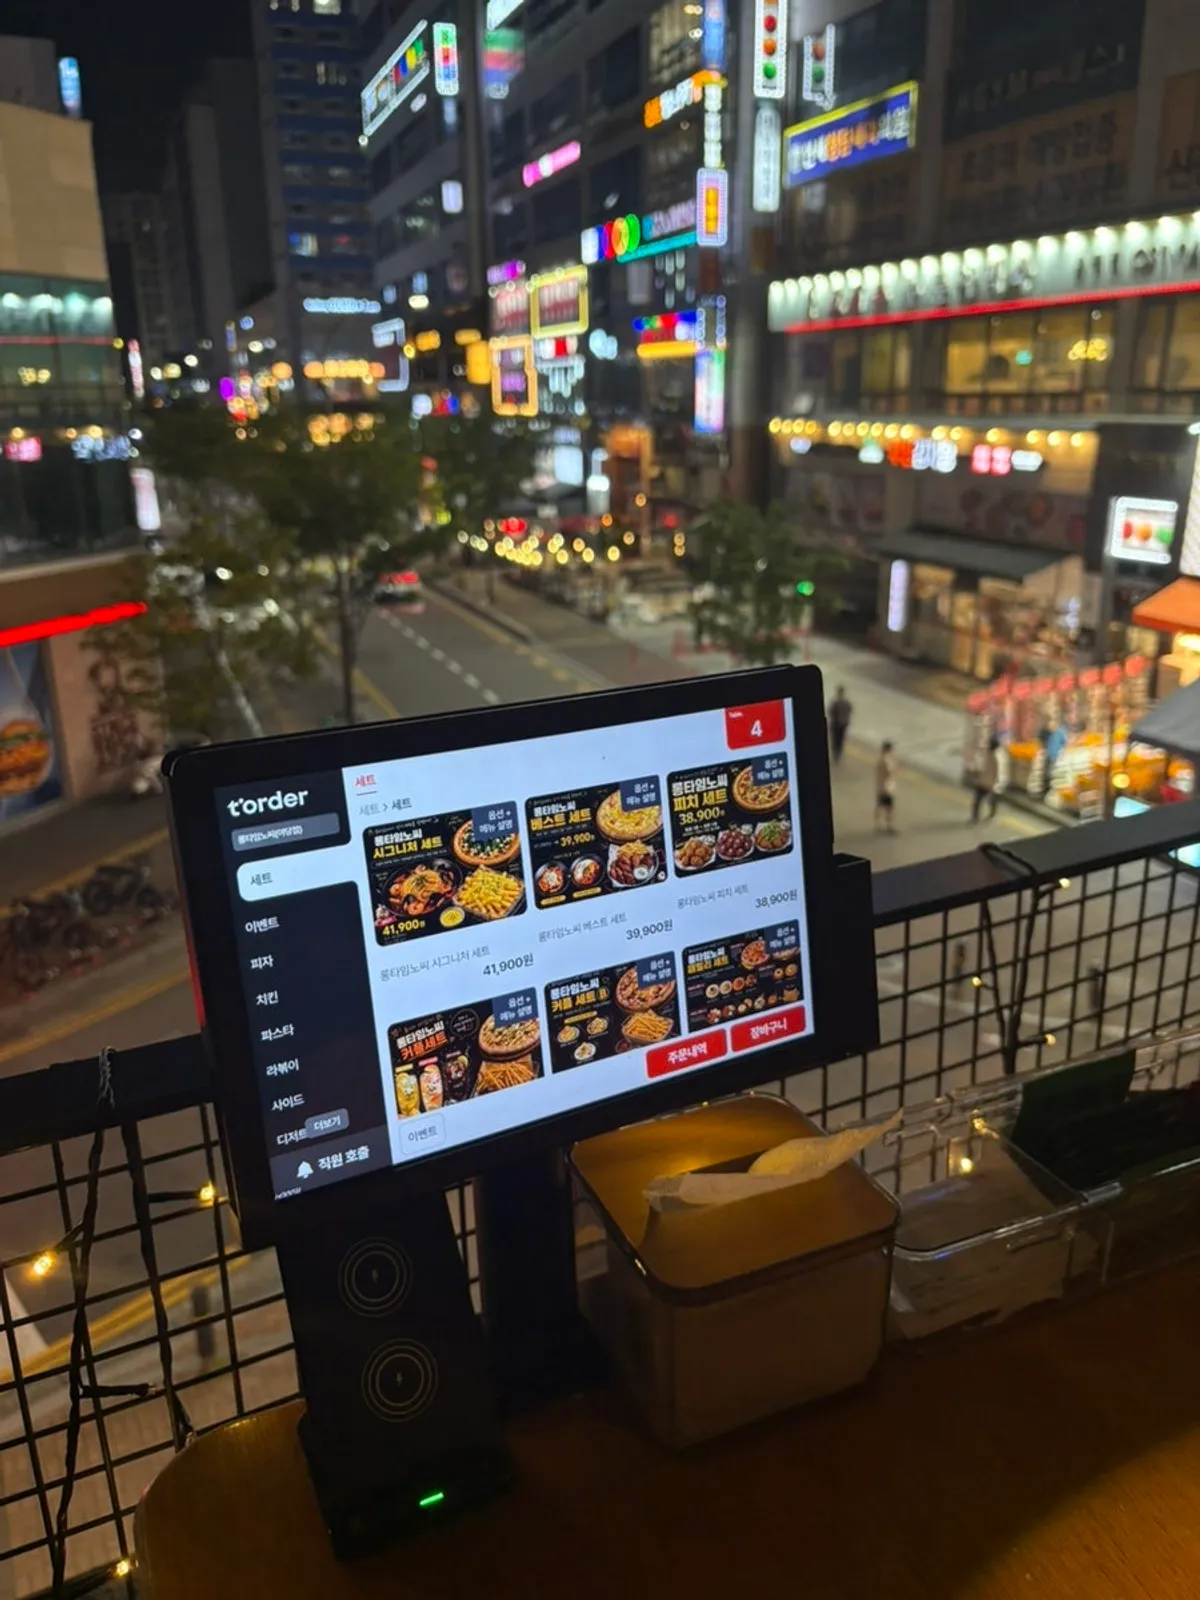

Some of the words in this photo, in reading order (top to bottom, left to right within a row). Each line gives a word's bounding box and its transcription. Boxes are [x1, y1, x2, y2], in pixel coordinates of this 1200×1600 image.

[750, 719, 763, 737] 4
[355, 774, 376, 788] 세트
[672, 773, 728, 797] 롱타임노씨
[359, 803, 381, 816] 세트
[392, 797, 412, 811] 세트
[673, 794, 699, 812] 피치
[702, 787, 728, 806] 세트
[530, 813, 566, 832] 베스트
[568, 807, 592, 824] 세트
[373, 842, 418, 860] 시그니처
[421, 835, 443, 851] 세트
[250, 872, 273, 887] 세트
[734, 883, 750, 896] 세트
[755, 889, 798, 908] 38,900원
[245, 916, 280, 933] 이벤트
[583, 917, 609, 931] 베스트
[610, 912, 628, 925] 세트
[625, 918, 673, 940] 39,900원
[250, 954, 274, 970] 피자
[380, 960, 430, 982] 롱타임노씨
[431, 949, 470, 969] 시그니처
[471, 944, 491, 958] 세트
[482, 952, 535, 977] 41,900원
[256, 990, 279, 1006] 치킨
[551, 996, 573, 1013] 커플
[574, 990, 597, 1006] 세트
[261, 1023, 295, 1041] 파스타
[396, 1020, 445, 1049] 롱타임노씨
[750, 1018, 788, 1039] 장바구니
[668, 1041, 708, 1064] 주문내역
[266, 1058, 300, 1077] 라볶이
[272, 1093, 305, 1111] 사이드
[313, 1115, 341, 1131] 더보기
[408, 1125, 438, 1142] 이벤트
[318, 1152, 344, 1170] 직원
[345, 1145, 370, 1163] 호출
